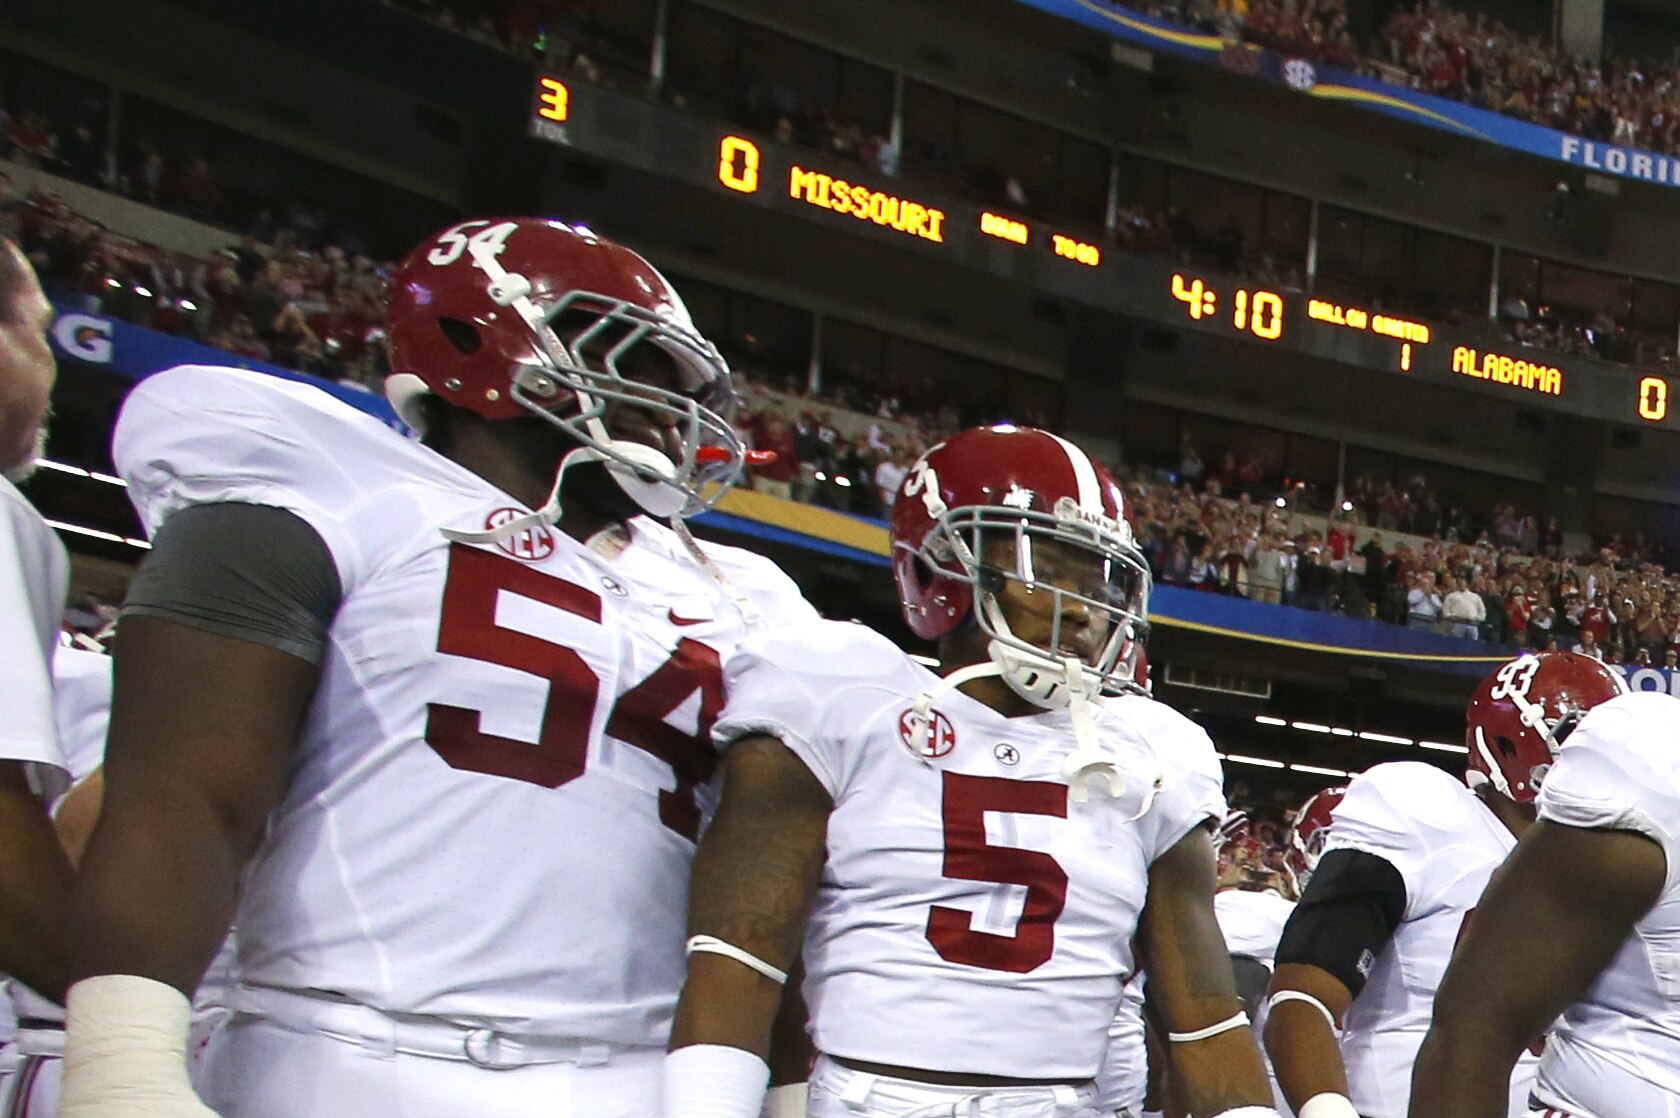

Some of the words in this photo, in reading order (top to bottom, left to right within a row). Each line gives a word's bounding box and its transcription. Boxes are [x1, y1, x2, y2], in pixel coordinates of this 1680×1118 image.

[539, 77, 569, 121] 3
[718, 135, 760, 194] 0
[790, 166, 944, 243] MISSOURI
[1452, 346, 1561, 395] ALABAMA
[1638, 377, 1668, 421] 0
[424, 540, 728, 846] 54
[1490, 654, 1541, 700] 93
[925, 770, 1070, 974] 5
